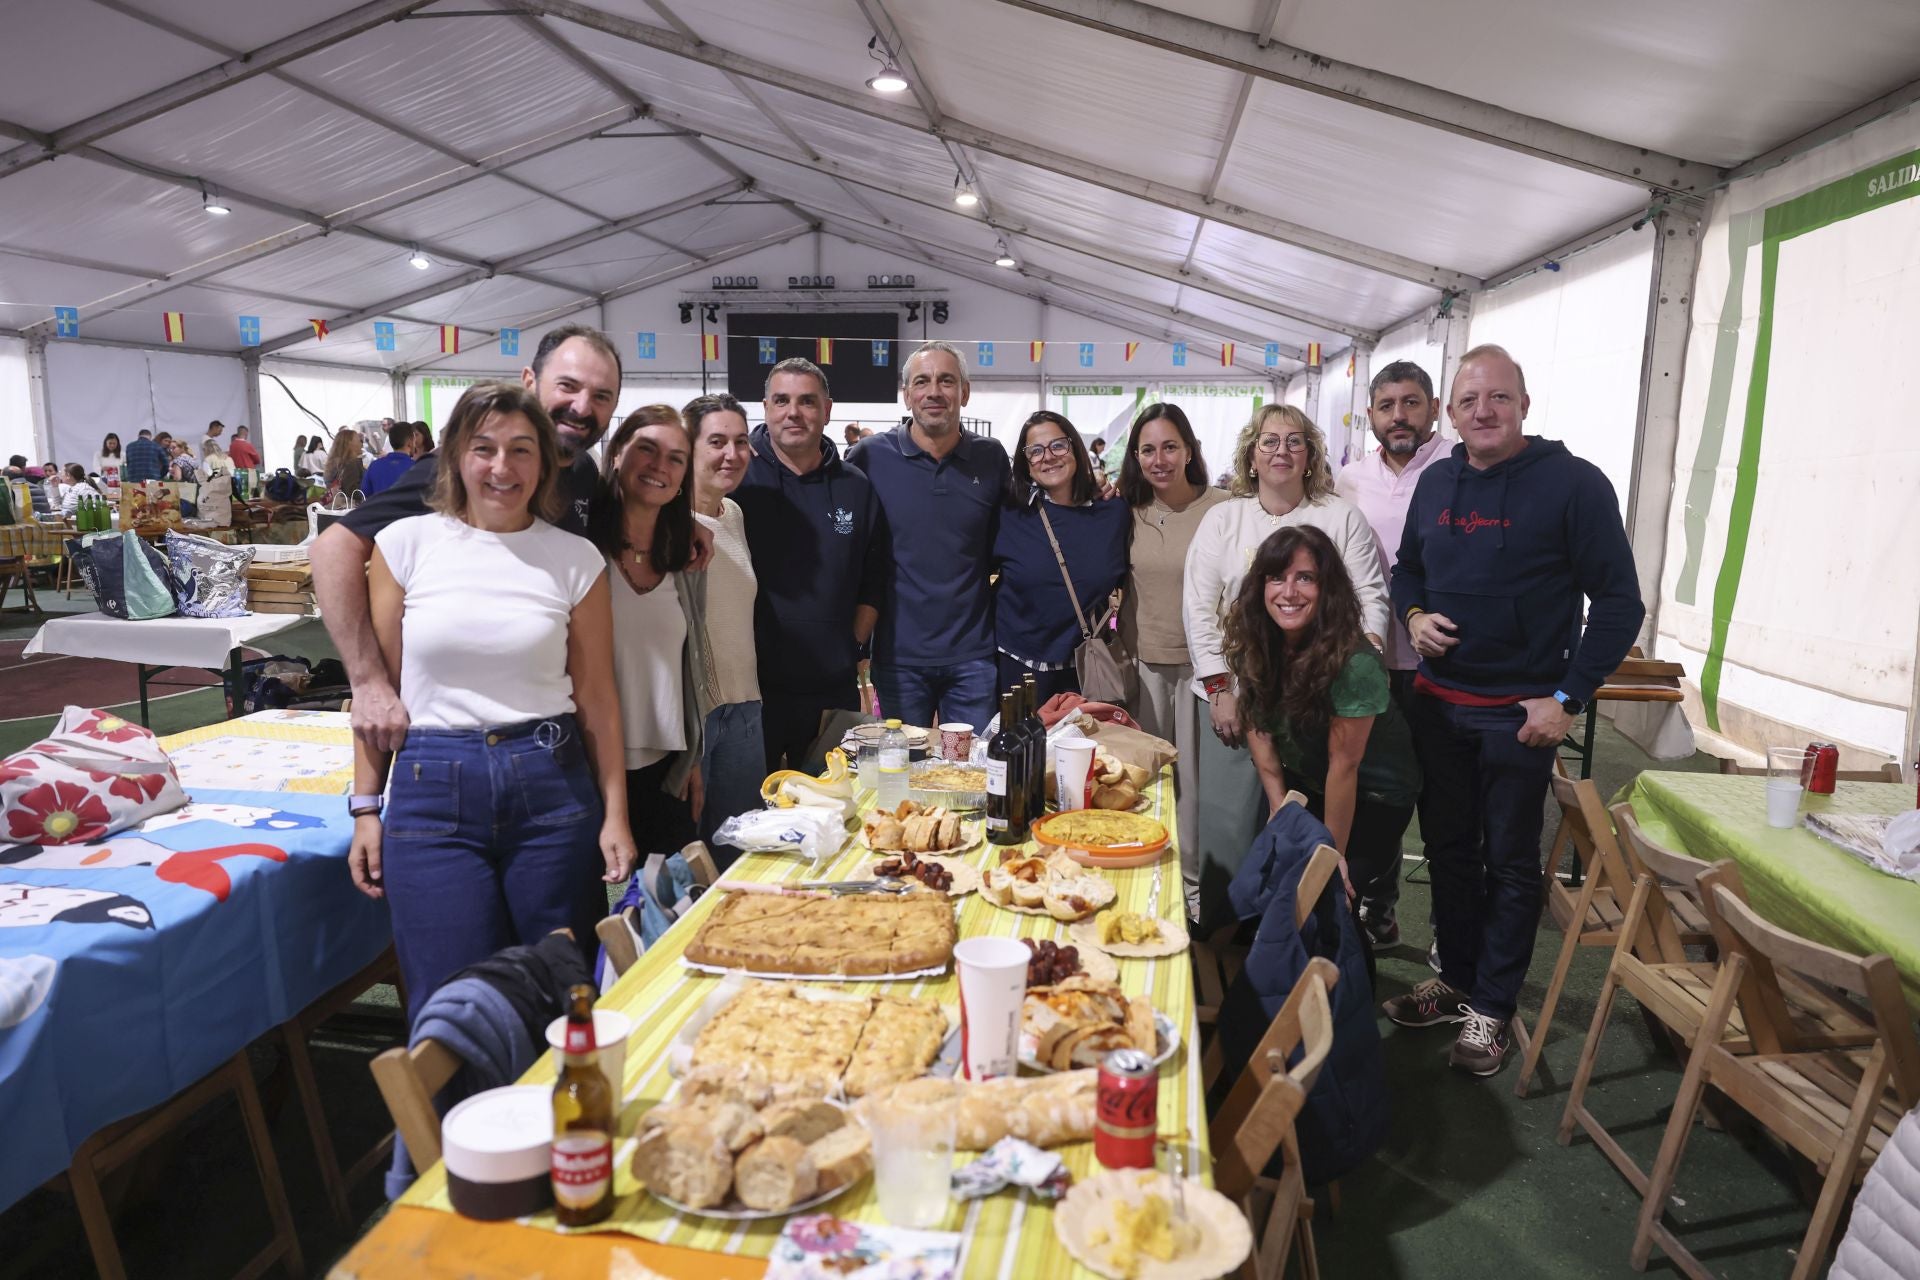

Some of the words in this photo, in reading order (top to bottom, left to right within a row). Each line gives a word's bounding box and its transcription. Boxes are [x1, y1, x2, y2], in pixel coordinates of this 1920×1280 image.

[1054, 386, 1096, 395] SALIDA
[1098, 386, 1114, 395] DE
[1166, 385, 1262, 397] EMERGENCIA
